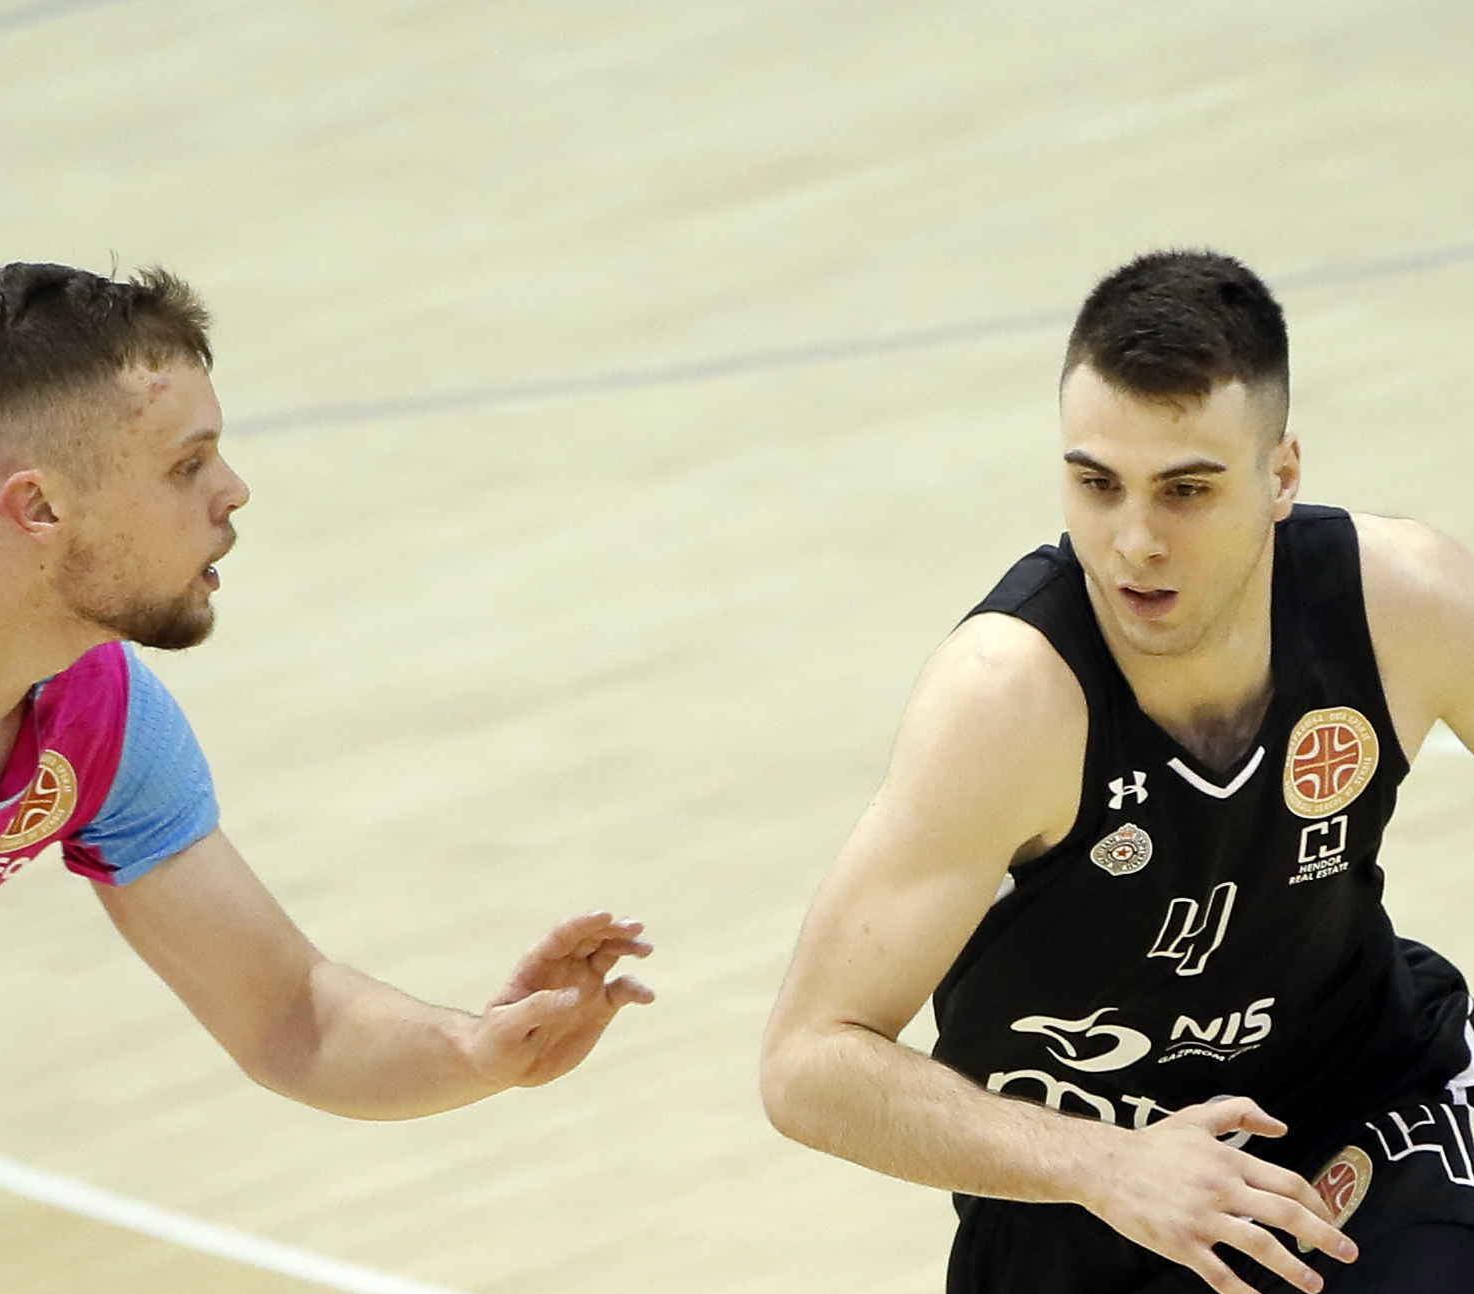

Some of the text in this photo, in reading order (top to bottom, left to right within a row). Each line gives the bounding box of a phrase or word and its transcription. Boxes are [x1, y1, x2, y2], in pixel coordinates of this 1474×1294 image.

[1288, 861, 1350, 886] REAL ESTATE
[1299, 854, 1342, 874] HENDOR
[1146, 881, 1238, 977] 4
[1170, 997, 1276, 1045] NIS
[1158, 1047, 1226, 1064] GAZPROM
